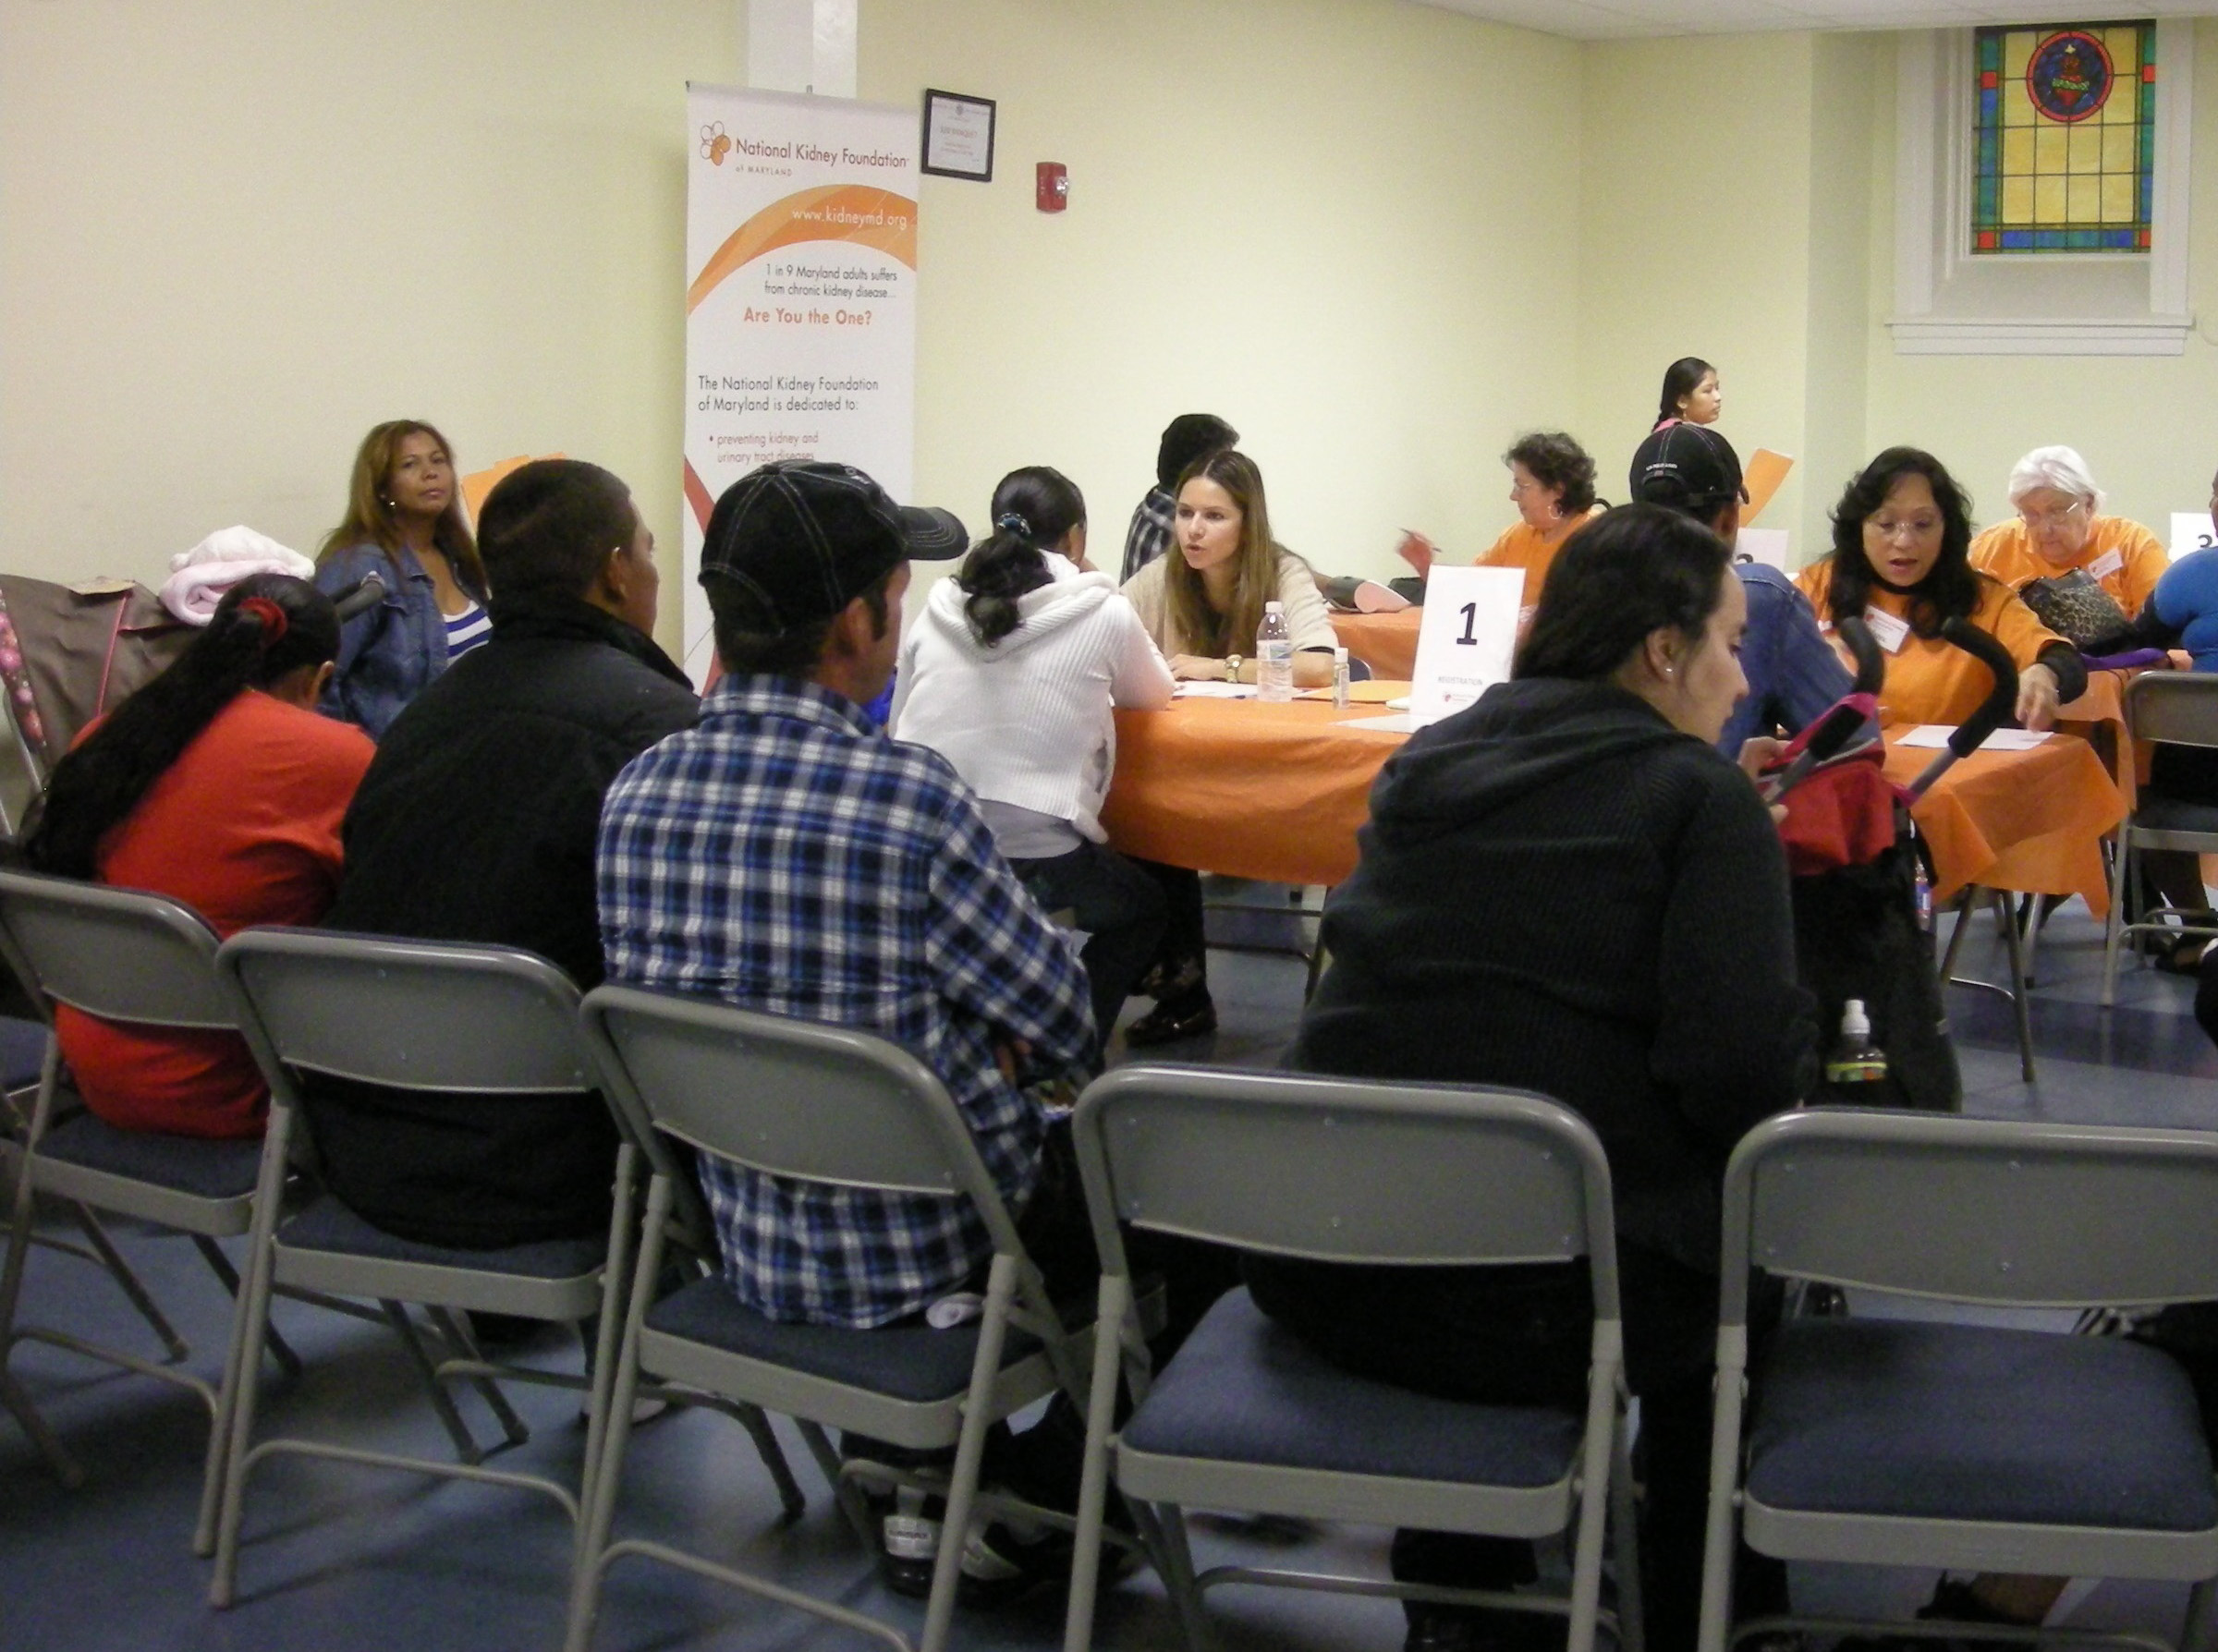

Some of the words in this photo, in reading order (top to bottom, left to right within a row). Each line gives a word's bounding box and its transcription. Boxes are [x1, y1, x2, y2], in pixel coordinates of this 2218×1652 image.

[737, 139, 791, 159] National
[796, 143, 838, 167] Kidney
[842, 148, 908, 168] Foundation
[748, 166, 793, 177] MARYLAND
[792, 205, 908, 231] www.kidneymd.org
[766, 263, 771, 275] 1
[775, 264, 784, 275] in
[786, 264, 793, 275] 9
[797, 266, 840, 282] Maryland
[843, 267, 869, 280] adults
[871, 268, 898, 281] suffers
[764, 281, 785, 295] from
[787, 283, 821, 296] chronic
[823, 284, 853, 299] kidney
[743, 307, 771, 322] Are
[775, 307, 802, 323] You
[808, 308, 830, 324] the
[835, 310, 872, 325] One?
[699, 375, 718, 391] The
[723, 375, 773, 391] National
[776, 375, 815, 395] Kidney
[819, 376, 879, 392] Foundation
[699, 396, 710, 411] of
[713, 397, 770, 415] Maryland
[773, 398, 782, 410] is
[786, 397, 841, 411] dedicated
[845, 398, 859, 411] to:
[717, 432, 766, 448] preventing
[769, 431, 799, 446] kidney
[802, 431, 819, 443] and
[717, 452, 752, 466] urinary
[754, 451, 774, 462] tract
[1456, 602, 1479, 646] 1
